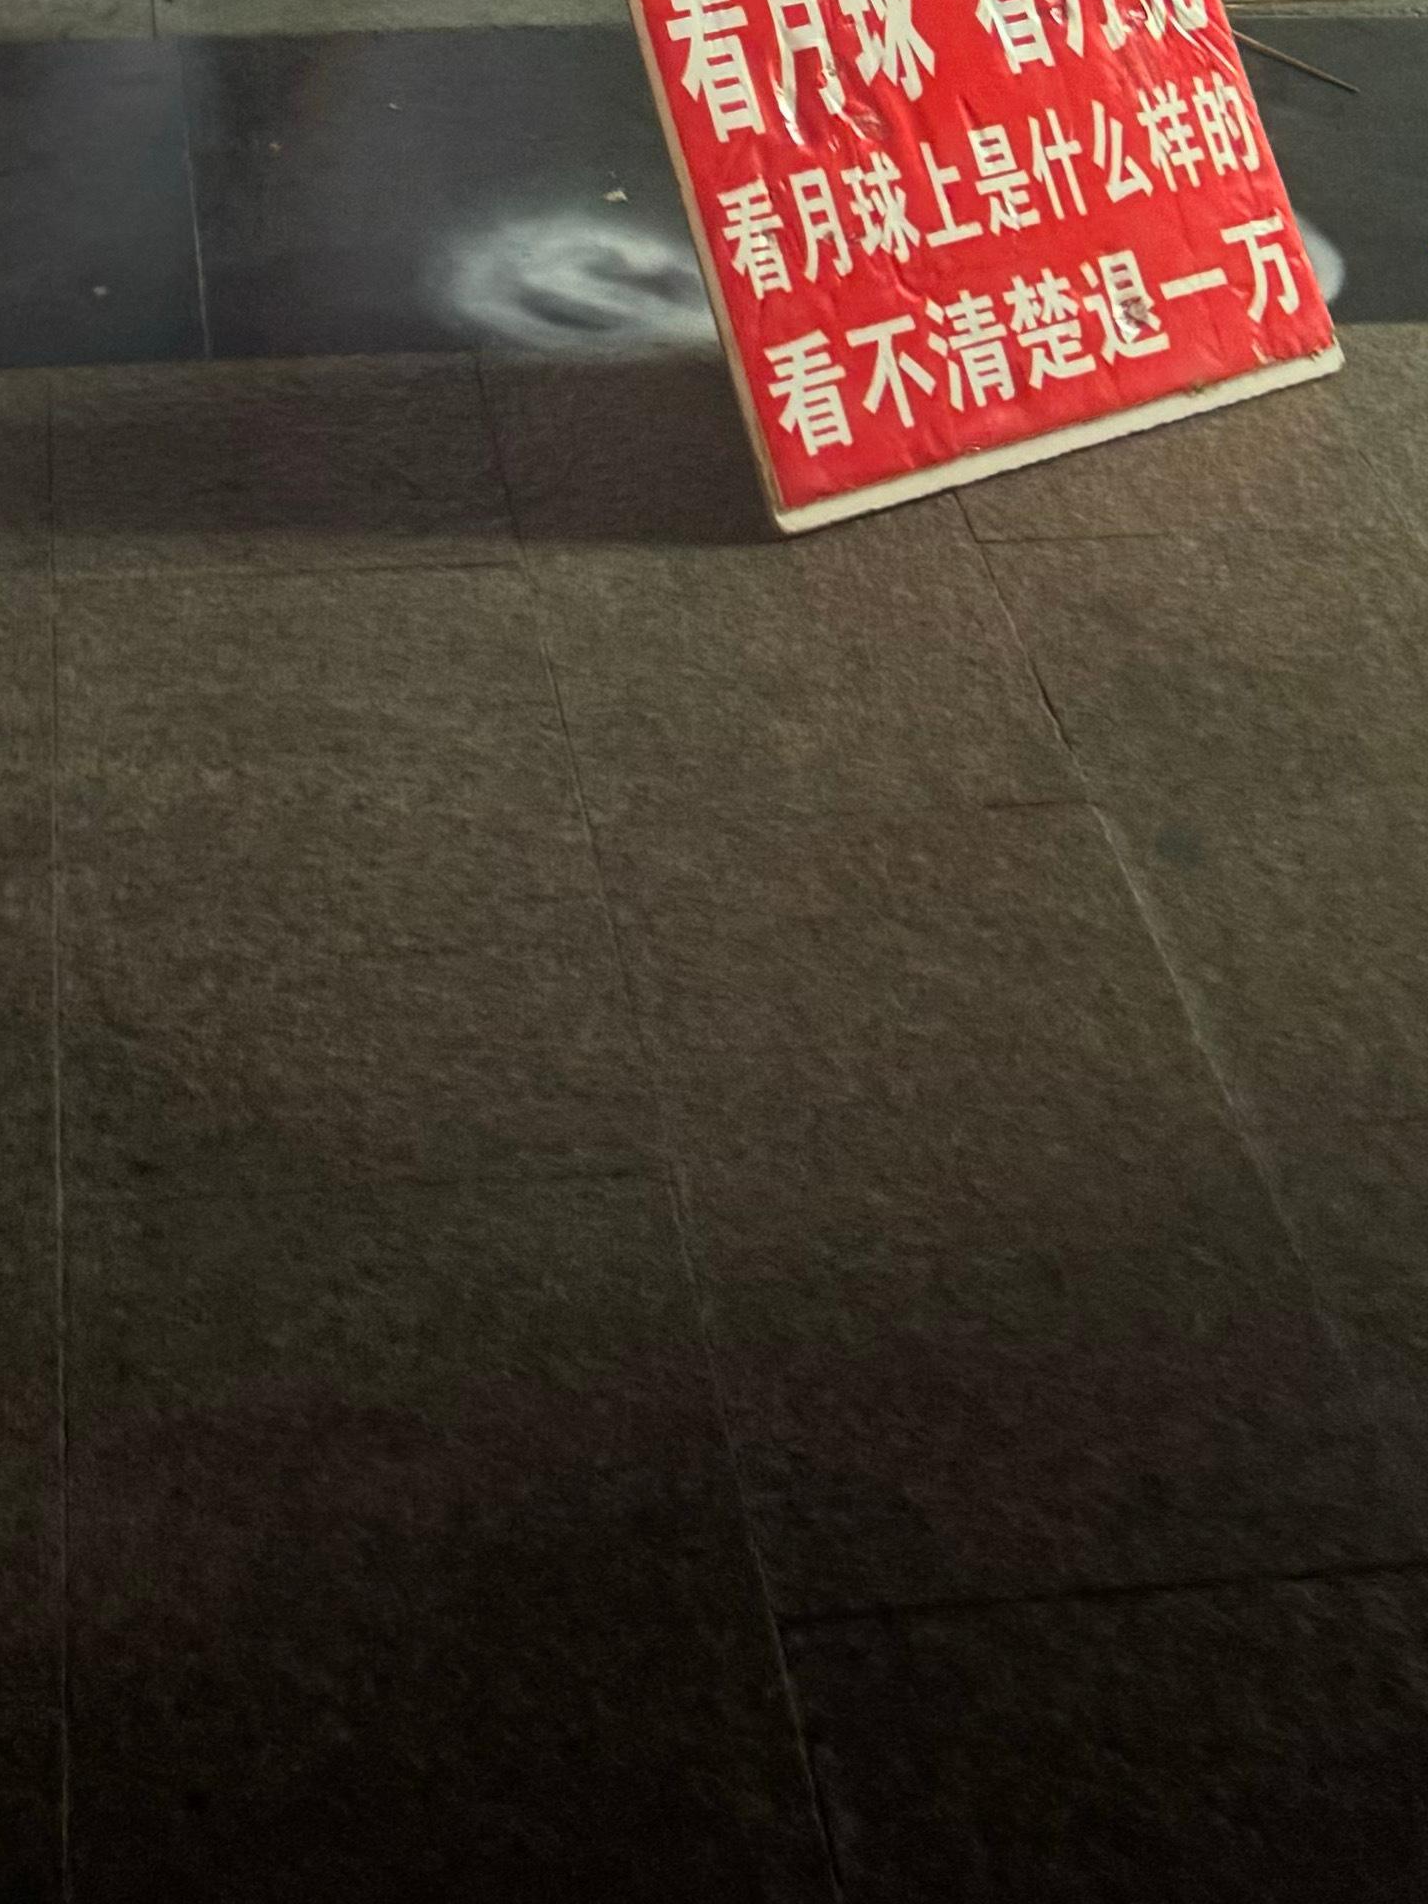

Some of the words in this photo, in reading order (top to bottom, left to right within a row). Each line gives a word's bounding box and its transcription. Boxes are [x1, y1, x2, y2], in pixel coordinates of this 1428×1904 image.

[717, 71, 1260, 299] 看月球上是什么样的
[764, 210, 1301, 457] 看不清楚退一万
